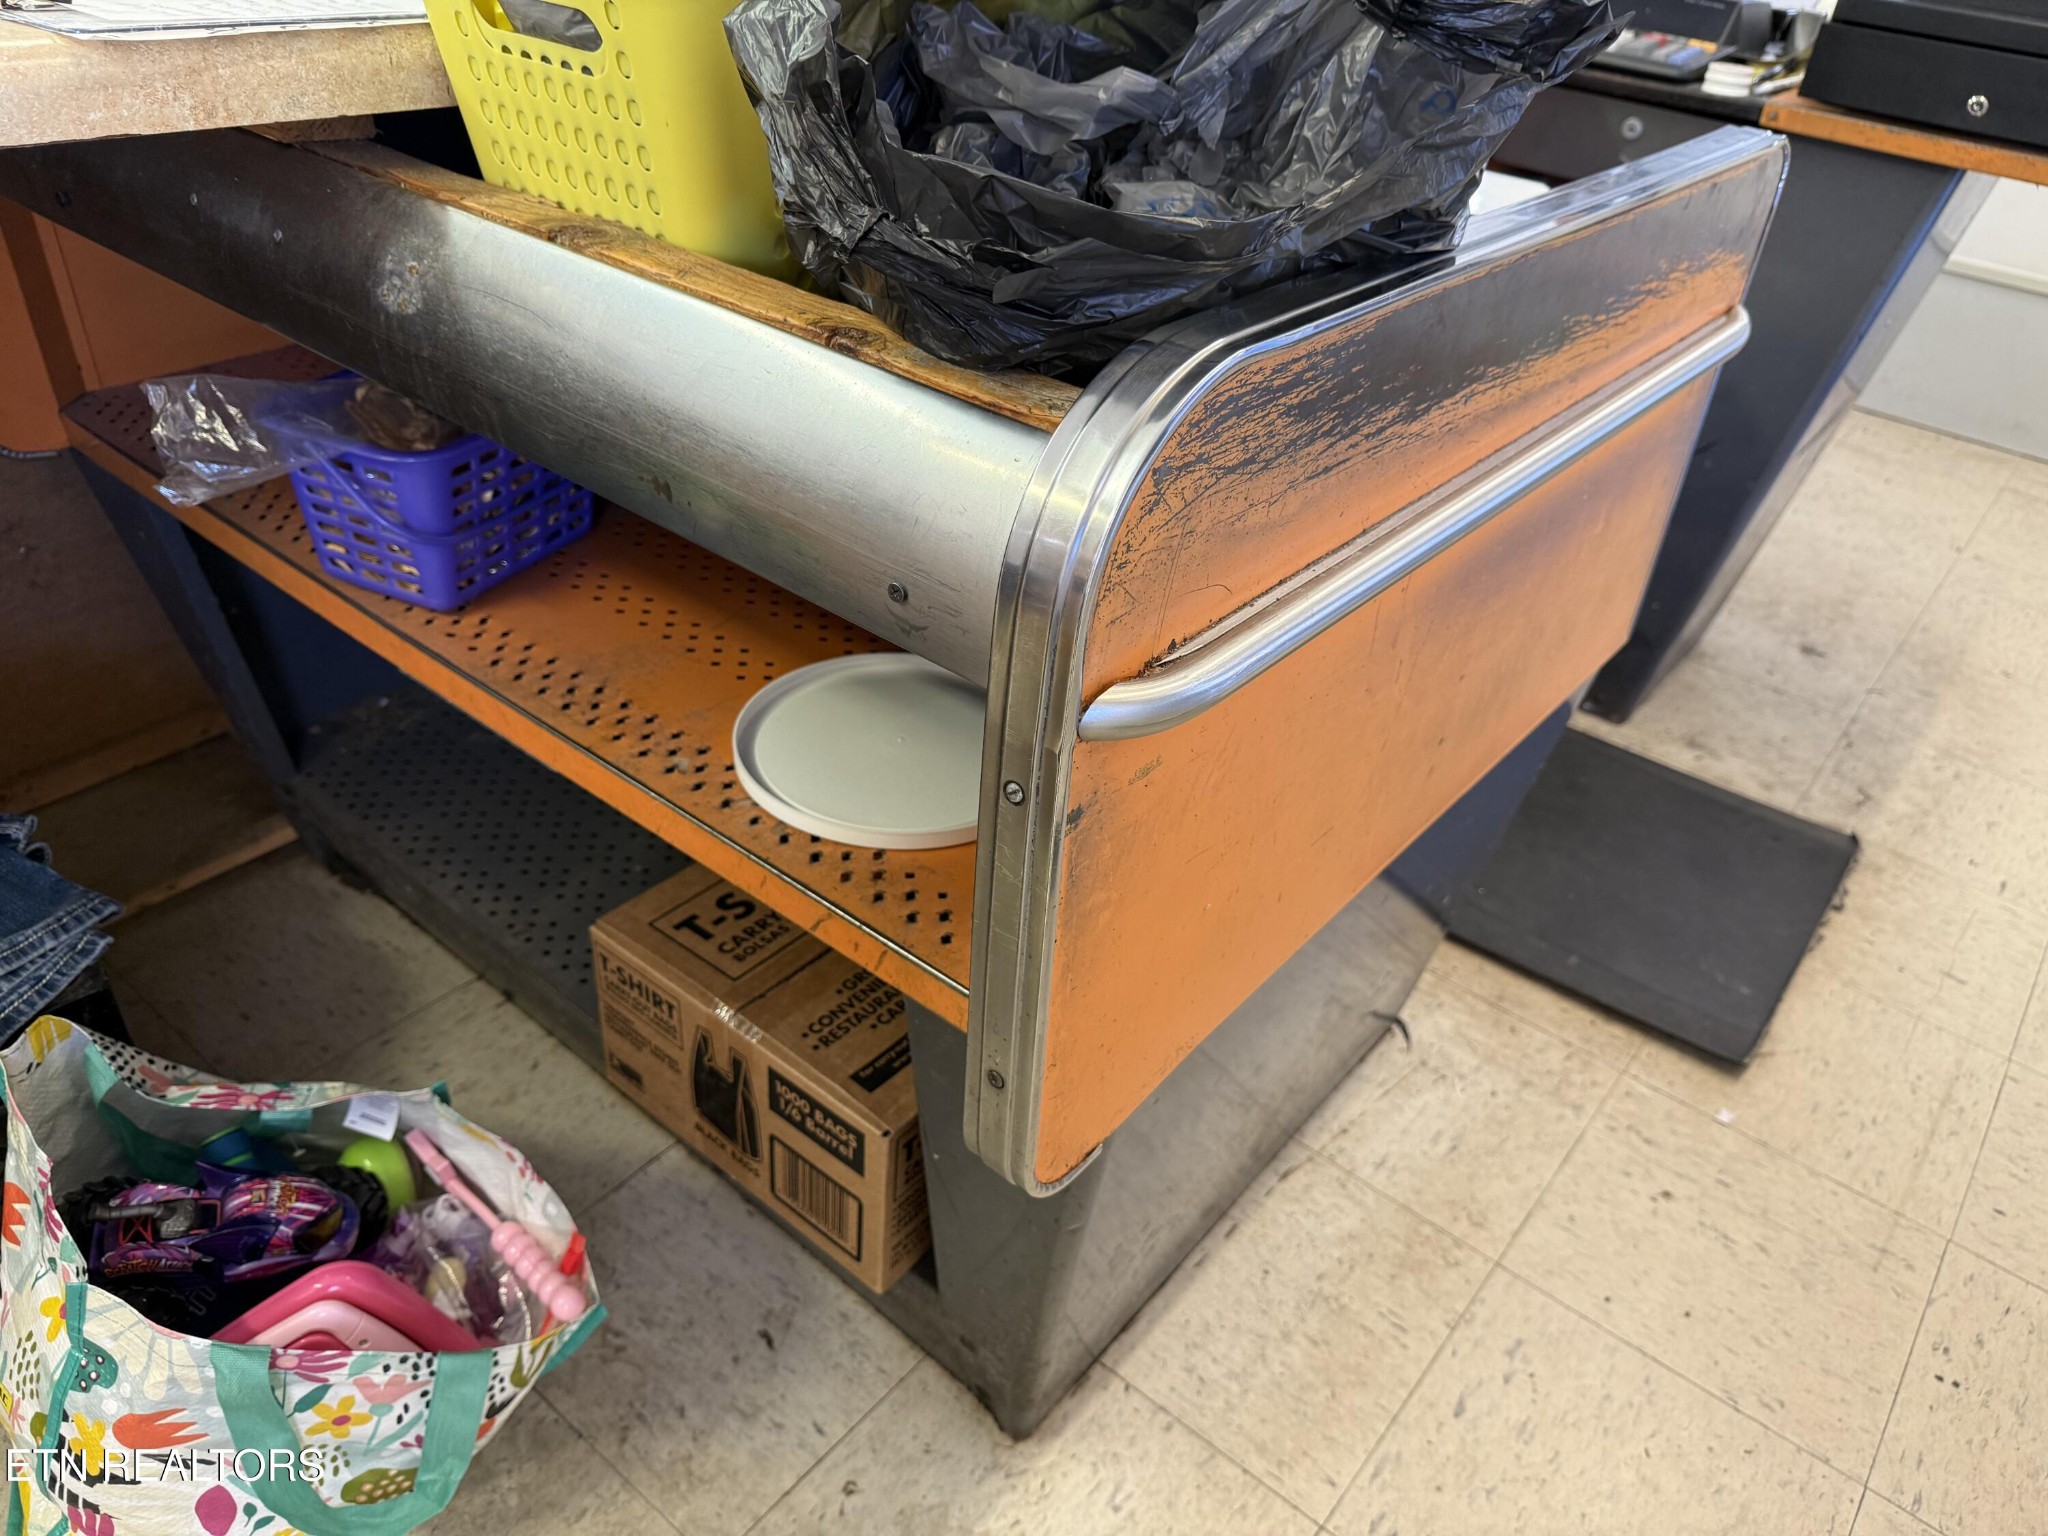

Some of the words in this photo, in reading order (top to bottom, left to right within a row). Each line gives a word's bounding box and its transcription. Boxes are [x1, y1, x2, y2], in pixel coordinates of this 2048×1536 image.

[718, 910, 783, 953] CARRY
[732, 924, 790, 962] BOLSAS
[600, 952, 675, 1019] T-SHIRT
[775, 1080, 811, 1114] 1000
[814, 1109, 857, 1148] BAGS
[780, 1096, 802, 1122] 1/6
[806, 1116, 854, 1159] Barrel
